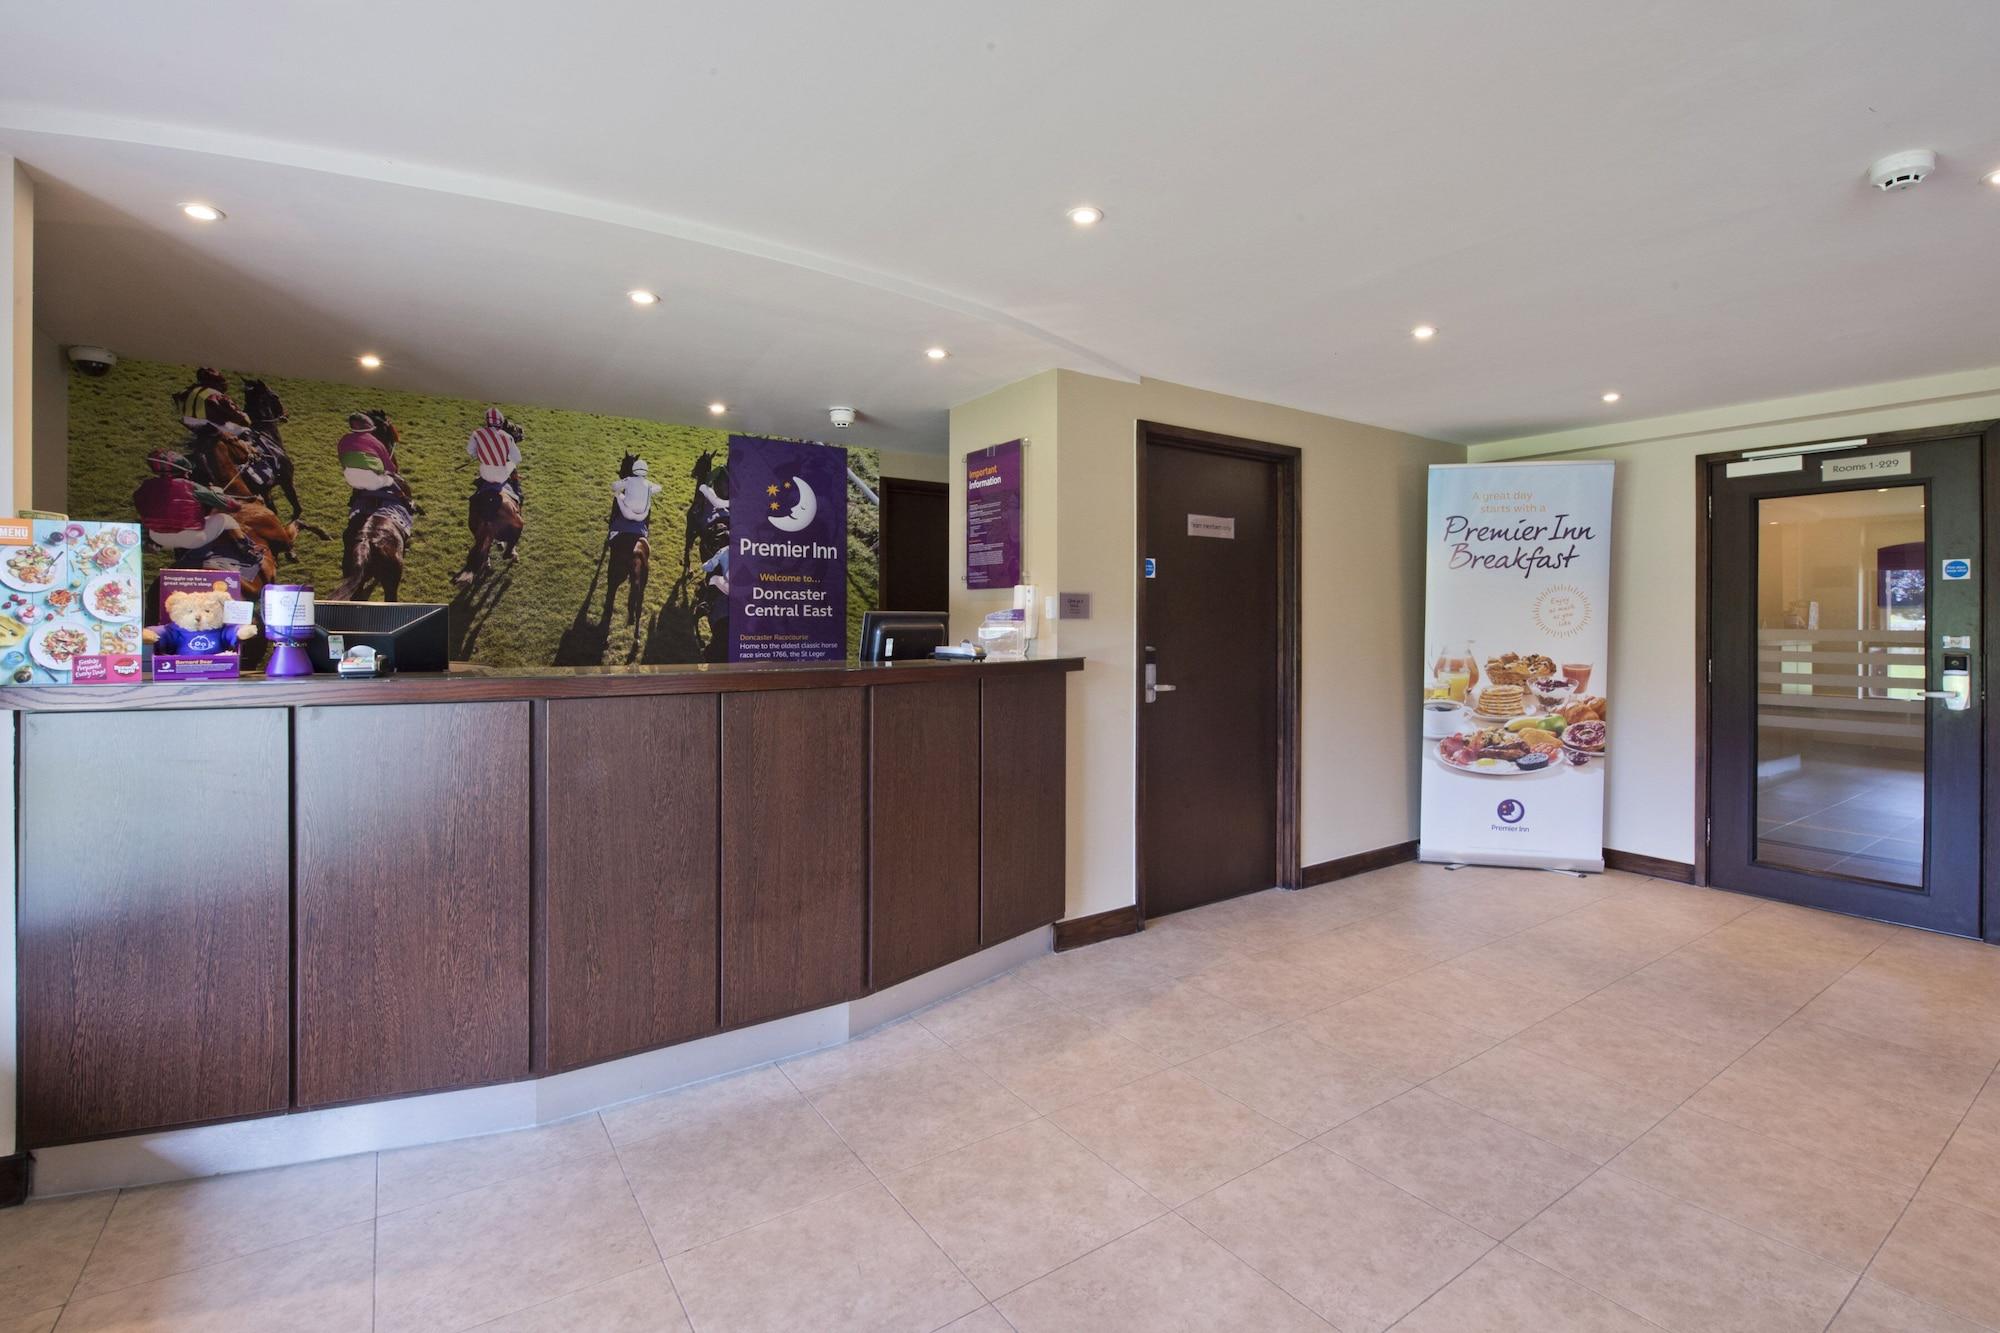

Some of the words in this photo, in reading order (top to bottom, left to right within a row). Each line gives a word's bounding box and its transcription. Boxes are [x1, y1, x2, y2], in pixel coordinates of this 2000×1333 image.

[1832, 464, 1866, 472] Rooms
[1869, 459, 1899, 469] 1-229
[1472, 492, 1479, 500] A
[1482, 492, 1510, 502] great
[1513, 491, 1533, 501] day
[1480, 504, 1511, 512] starts
[1514, 504, 1537, 512] with
[0, 528, 28, 537] MENU
[1443, 515, 1548, 542] Premier
[1548, 514, 1596, 541] Inn
[740, 538, 810, 558] Premier
[813, 542, 838, 560] Inn
[1448, 542, 1580, 578] Breakfast
[760, 573, 801, 582] Welcome
[753, 587, 827, 600] Doncaster
[745, 604, 799, 617] Central
[803, 605, 833, 617] East
